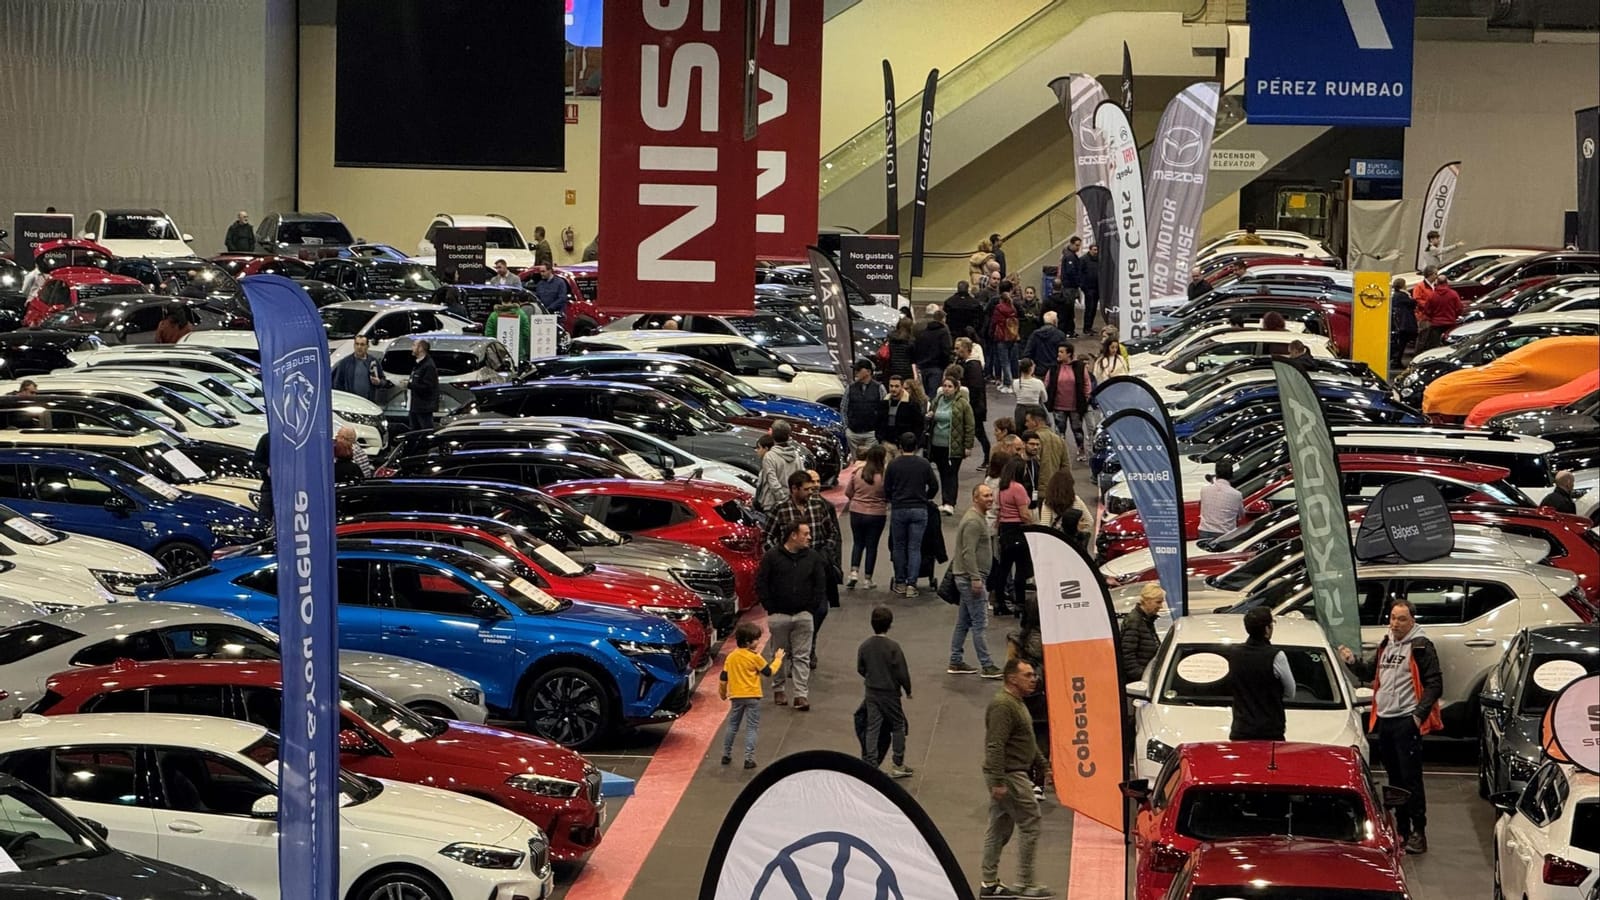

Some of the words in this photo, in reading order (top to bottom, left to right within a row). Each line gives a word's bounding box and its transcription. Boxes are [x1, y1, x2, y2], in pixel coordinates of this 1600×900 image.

[1257, 76, 1317, 96] PÉREZ
[1325, 82, 1404, 97] RUMBAO
[1213, 152, 1256, 160] ASCENSOR
[1213, 160, 1256, 168] ELEVATOR
[1156, 198, 1178, 261] MOTOR
[457, 243, 483, 252] gustaría
[849, 252, 864, 260] Nos
[865, 252, 894, 262] gustaría
[1173, 224, 1195, 297] URENSE
[458, 262, 483, 270] opinión
[866, 273, 894, 281] opinión
[1391, 525, 1420, 541] Balpersa
